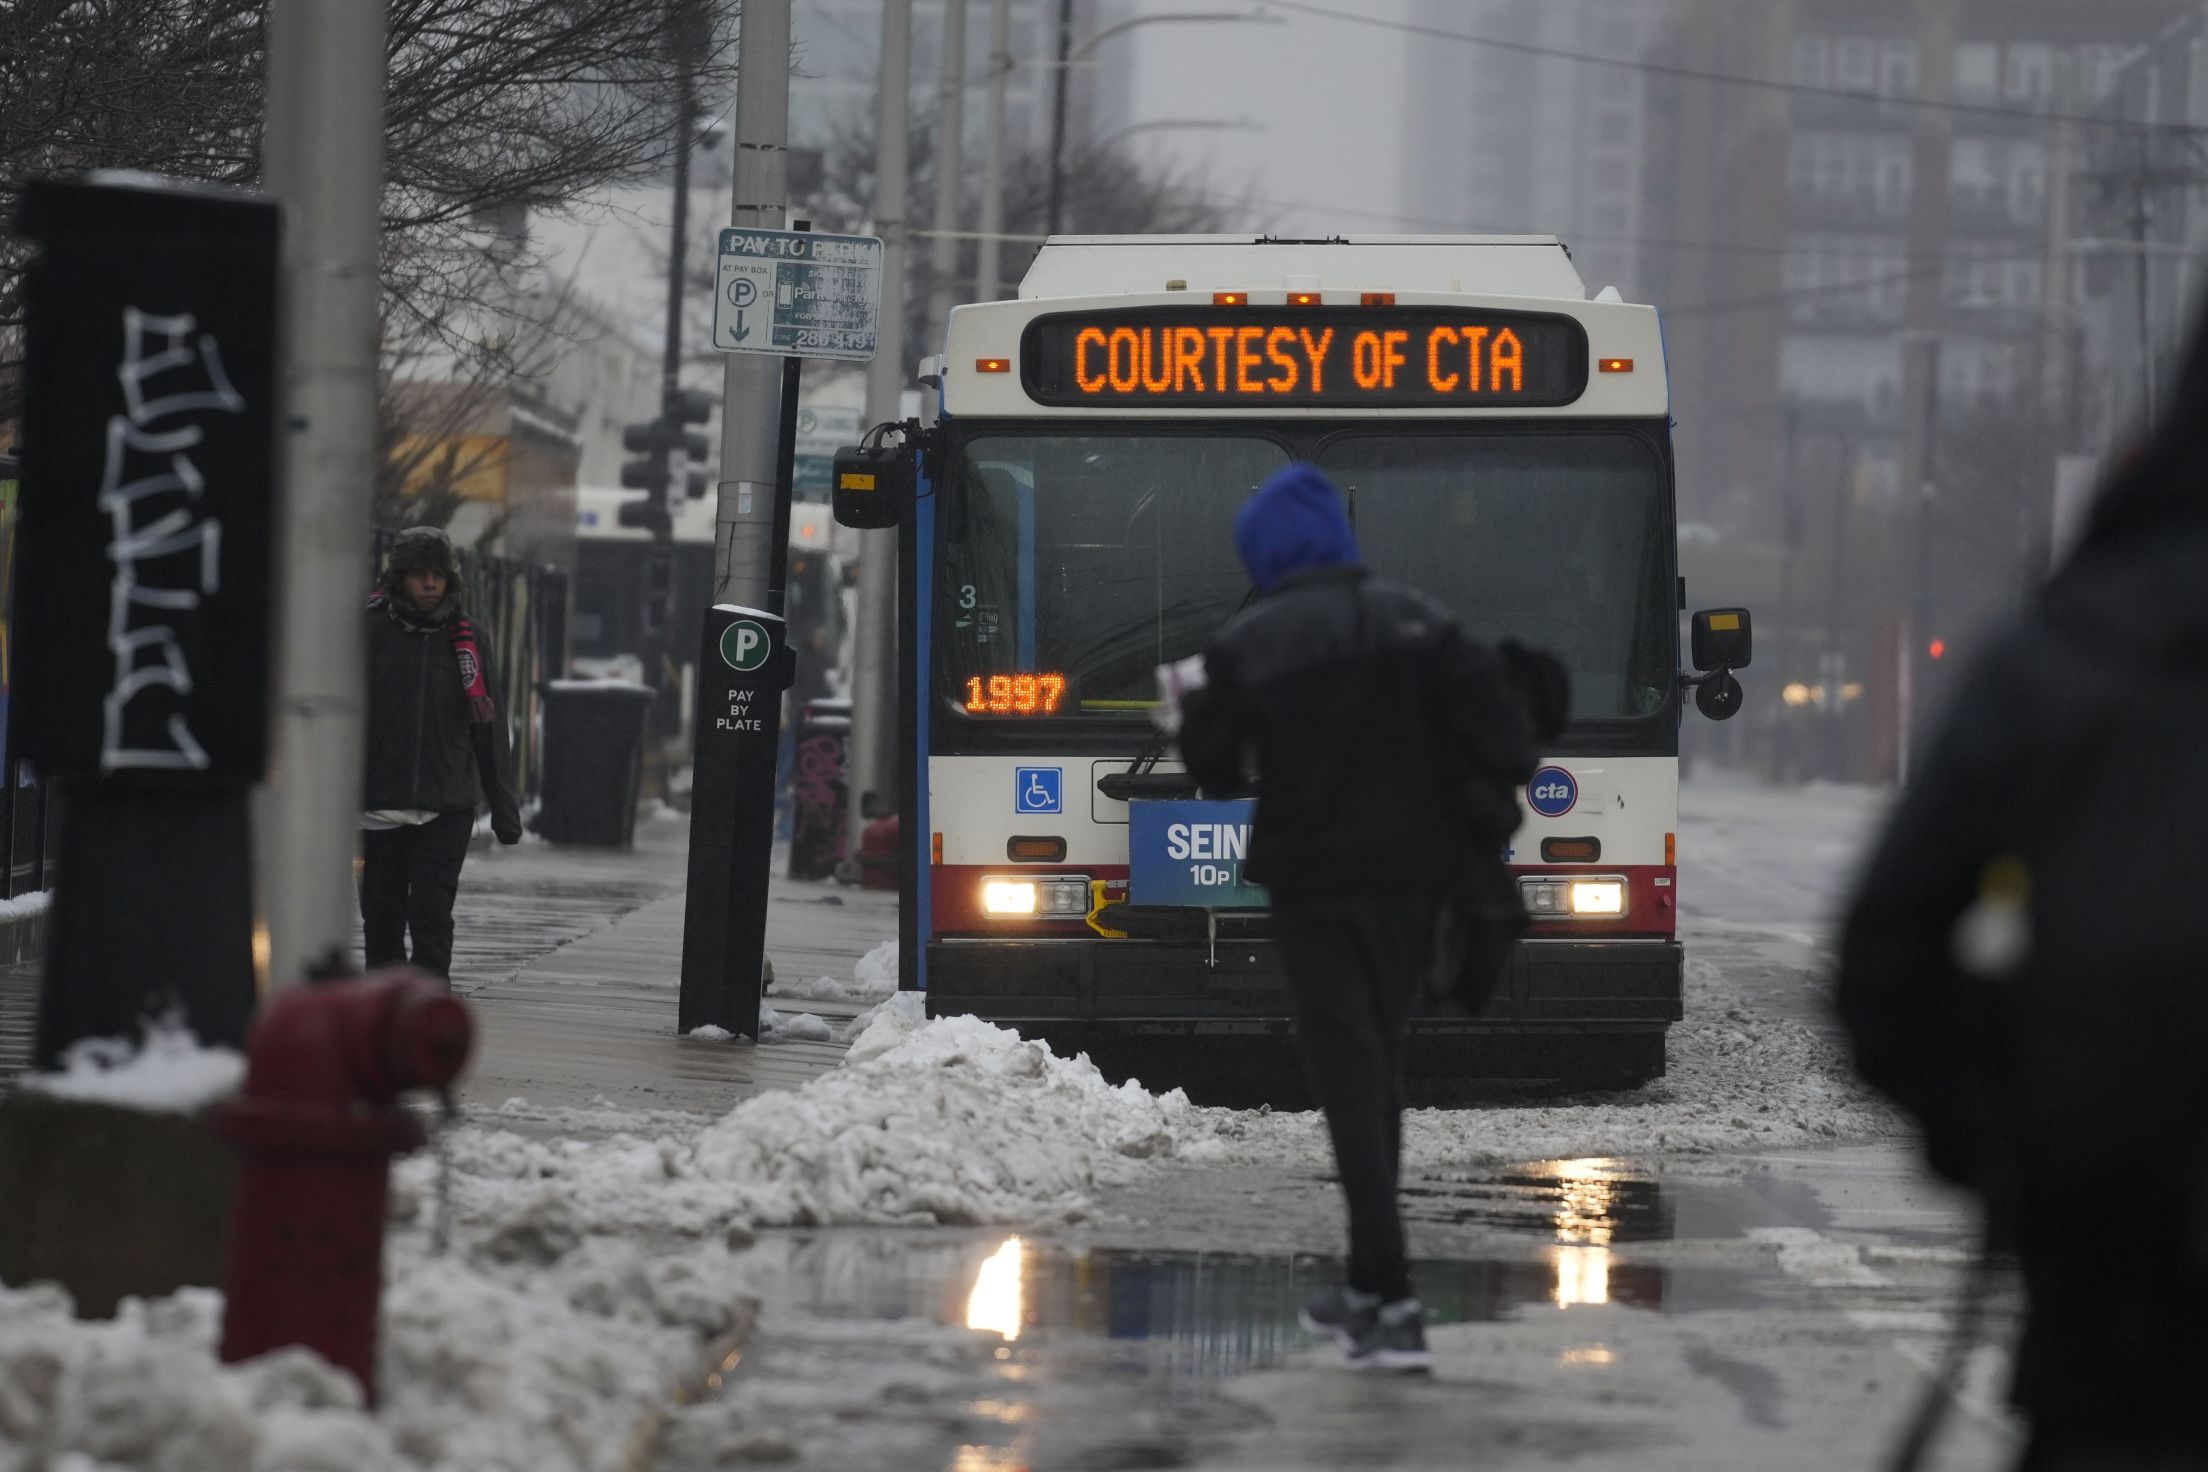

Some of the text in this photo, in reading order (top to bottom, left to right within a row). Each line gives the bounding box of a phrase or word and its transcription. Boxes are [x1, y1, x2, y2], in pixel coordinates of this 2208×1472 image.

[730, 235, 769, 254] PAY
[776, 238, 805, 256] TO
[735, 283, 751, 302] P
[763, 290, 774, 298] OR
[1074, 326, 1523, 393] COURTESY OF CTA
[959, 585, 976, 608] 3
[736, 628, 759, 662] P
[728, 689, 754, 702] PAY
[965, 674, 1066, 712] 1997
[730, 705, 749, 716] BY
[716, 718, 761, 731] PLATE
[1535, 782, 1569, 800] cta
